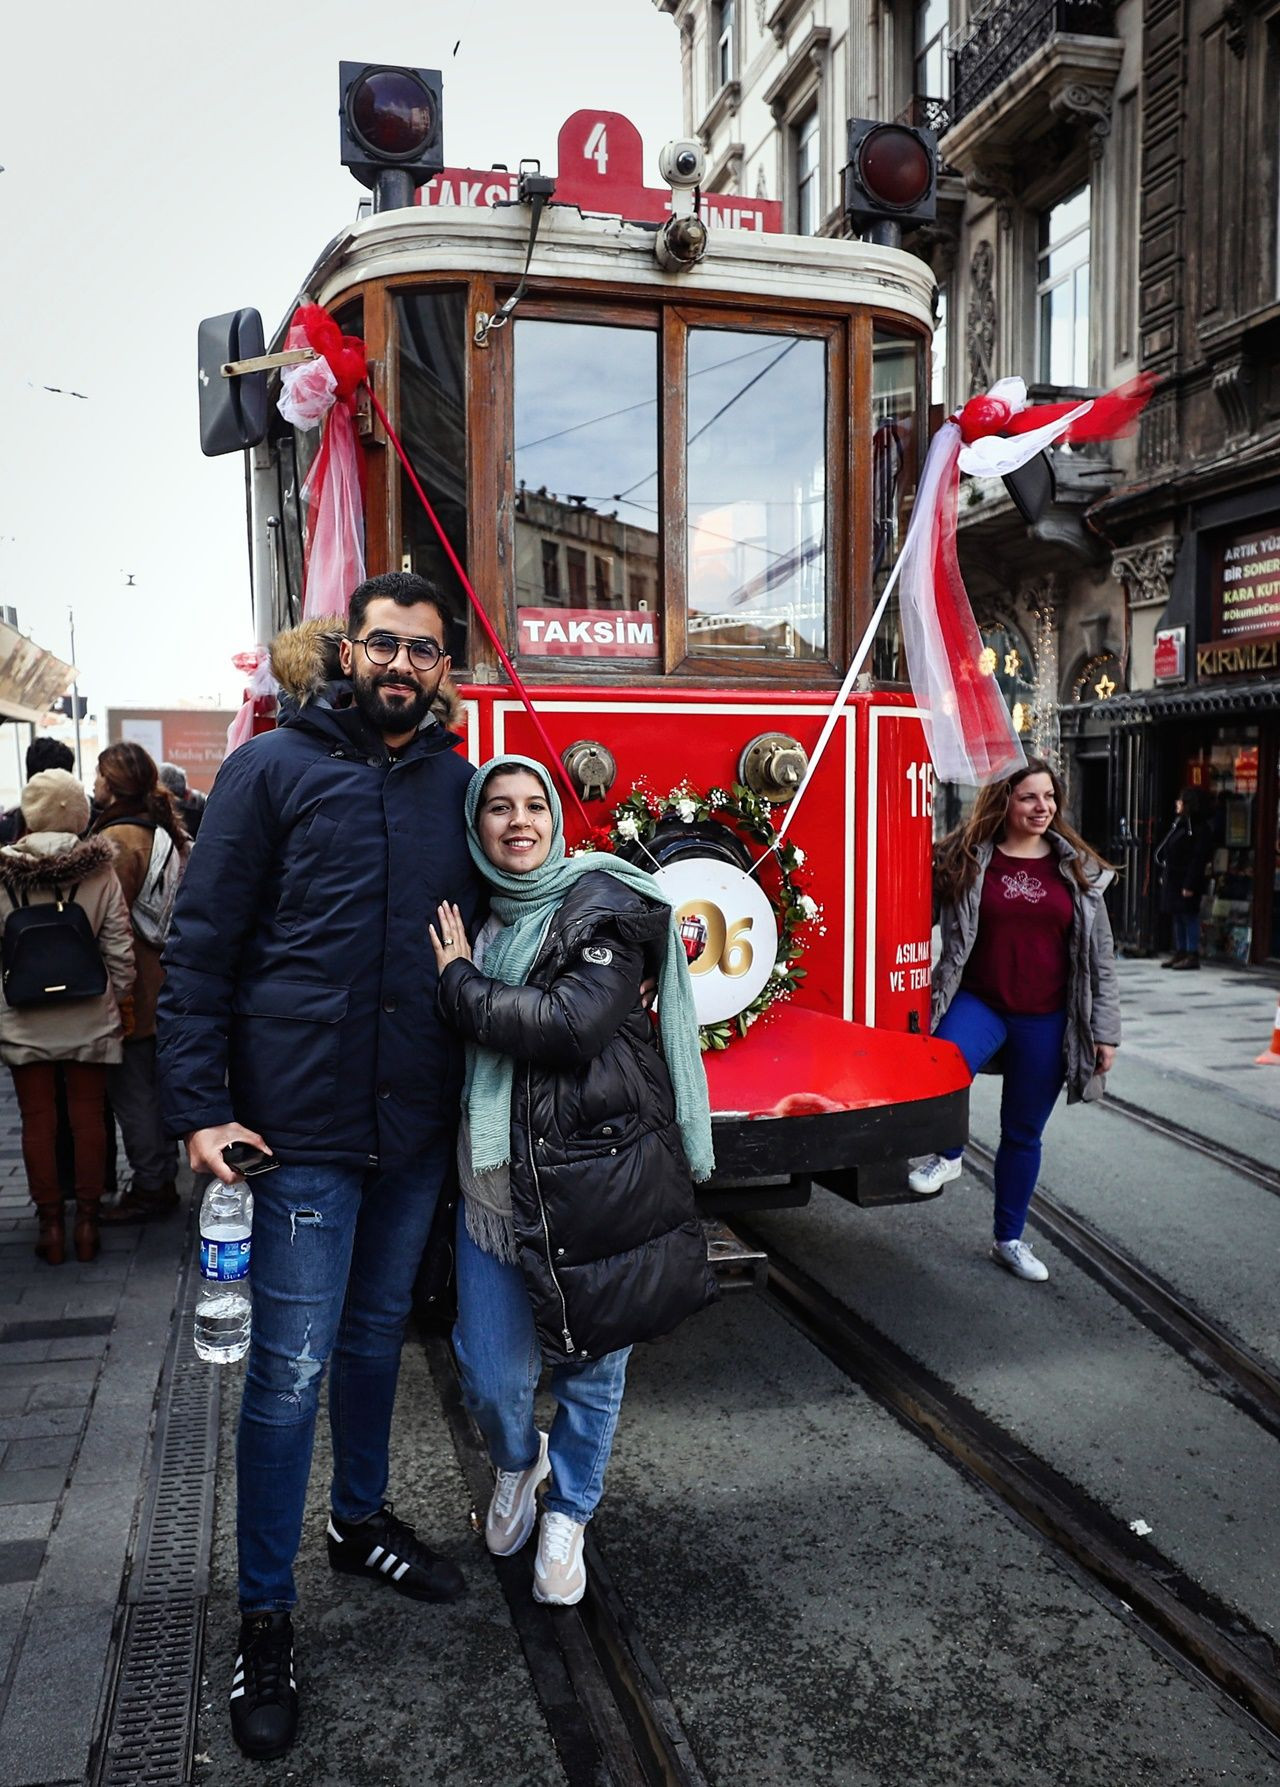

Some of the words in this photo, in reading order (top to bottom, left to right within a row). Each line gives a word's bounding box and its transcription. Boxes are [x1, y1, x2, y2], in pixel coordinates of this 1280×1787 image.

[584, 123, 608, 174] 4
[421, 177, 520, 207] TAKSİ
[1224, 541, 1258, 562] ARTIK
[1223, 565, 1242, 582] BİR
[1223, 586, 1255, 604] KARA
[1256, 580, 1280, 598] KUT
[523, 617, 653, 644] TAKSİM
[1197, 641, 1277, 676] KIRMIZI
[890, 970, 906, 992] VE
